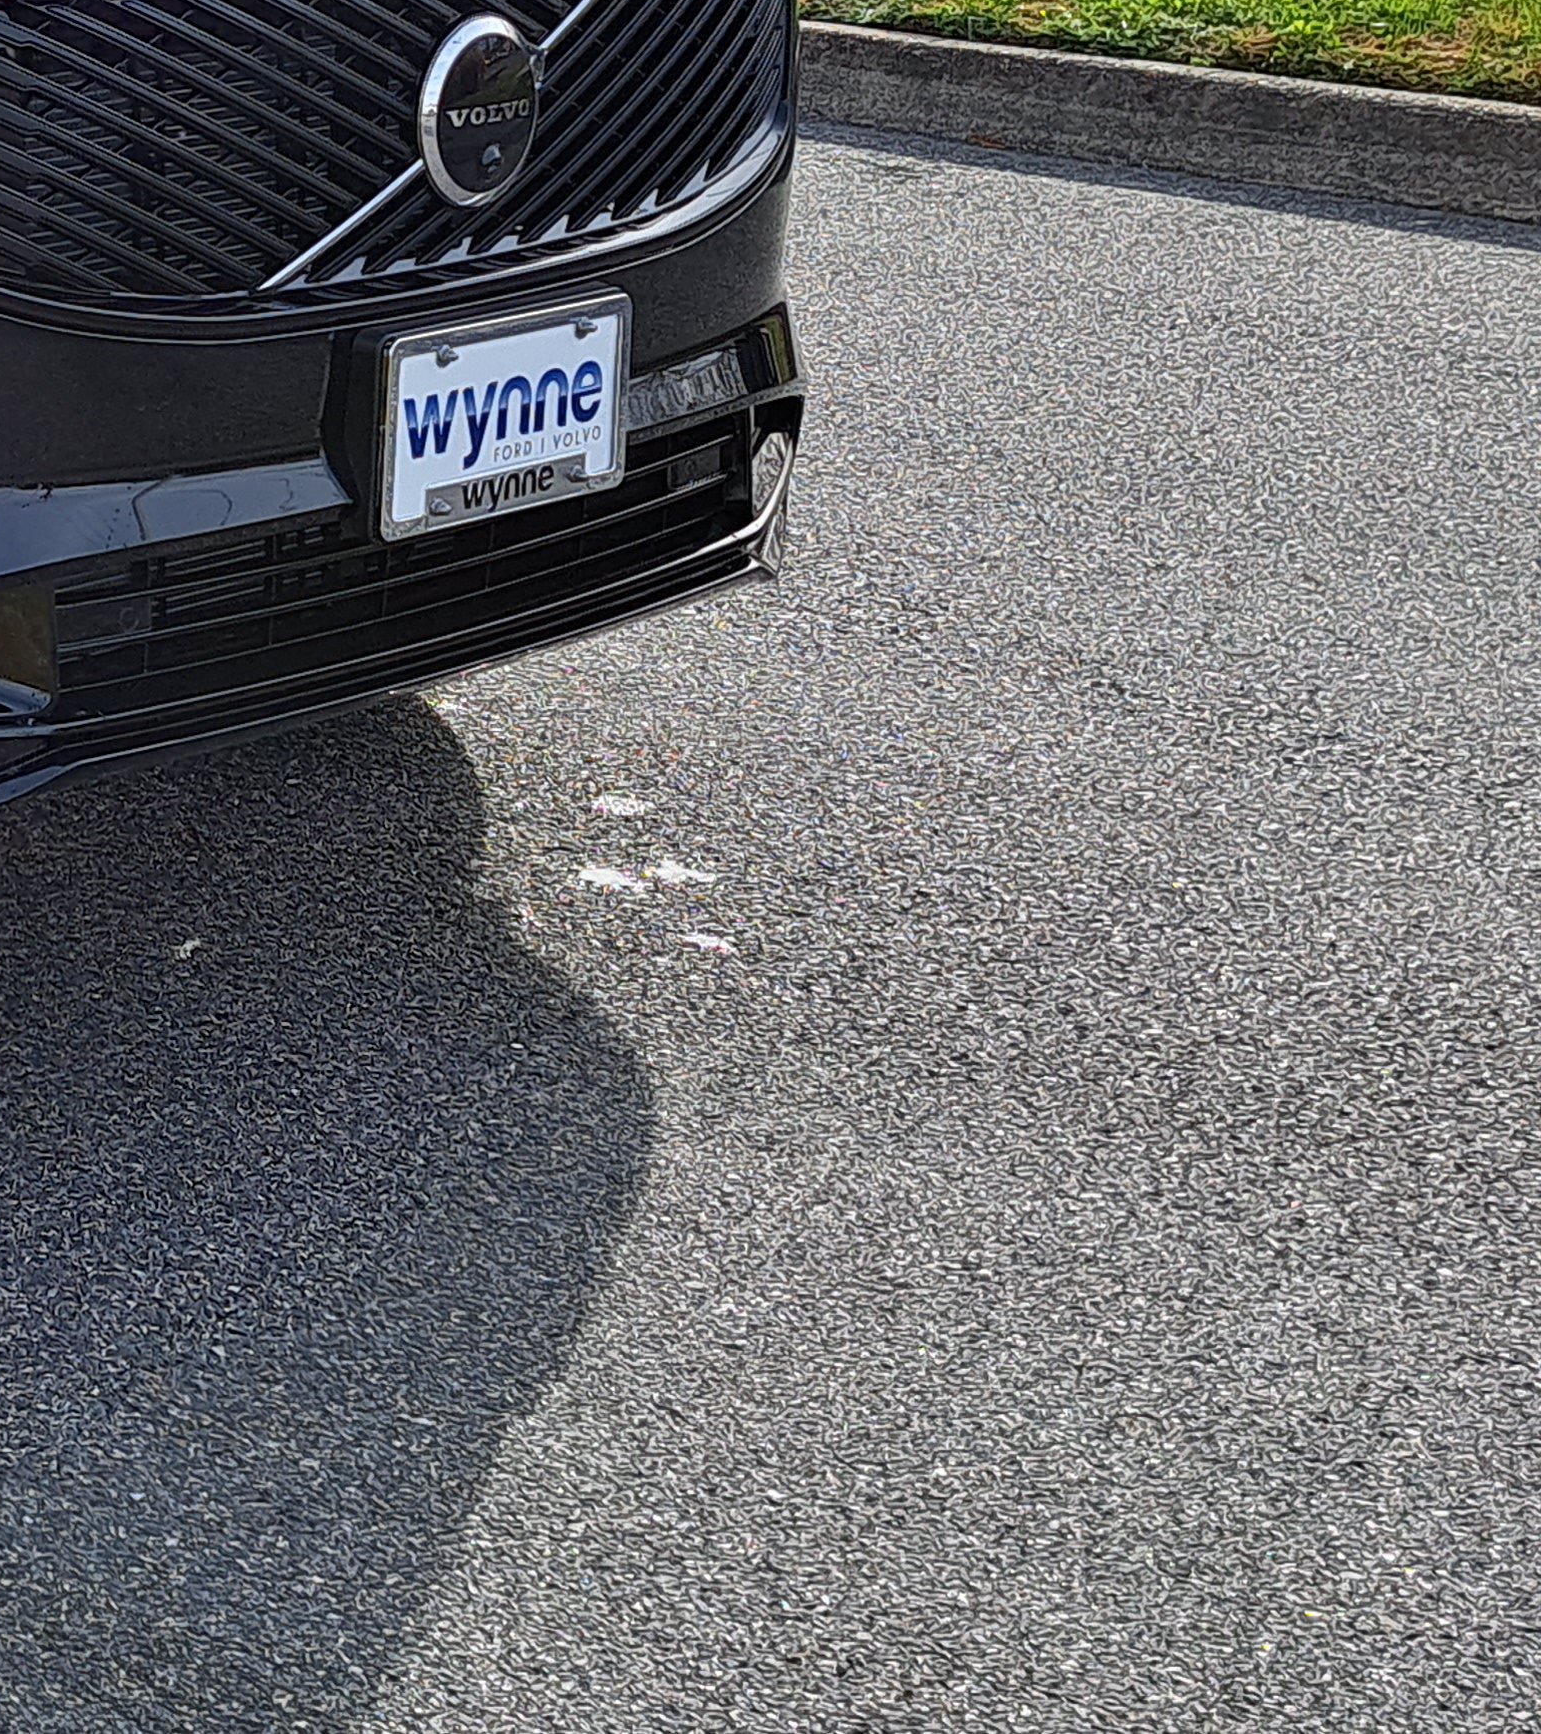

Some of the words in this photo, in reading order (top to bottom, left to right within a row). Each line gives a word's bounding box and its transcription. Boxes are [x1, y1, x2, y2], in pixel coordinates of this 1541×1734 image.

[445, 98, 530, 128] VOLVO
[403, 360, 603, 470] wynne
[493, 440, 533, 463] FORD
[553, 425, 602, 449] VOLVO
[461, 464, 555, 512] wynne
